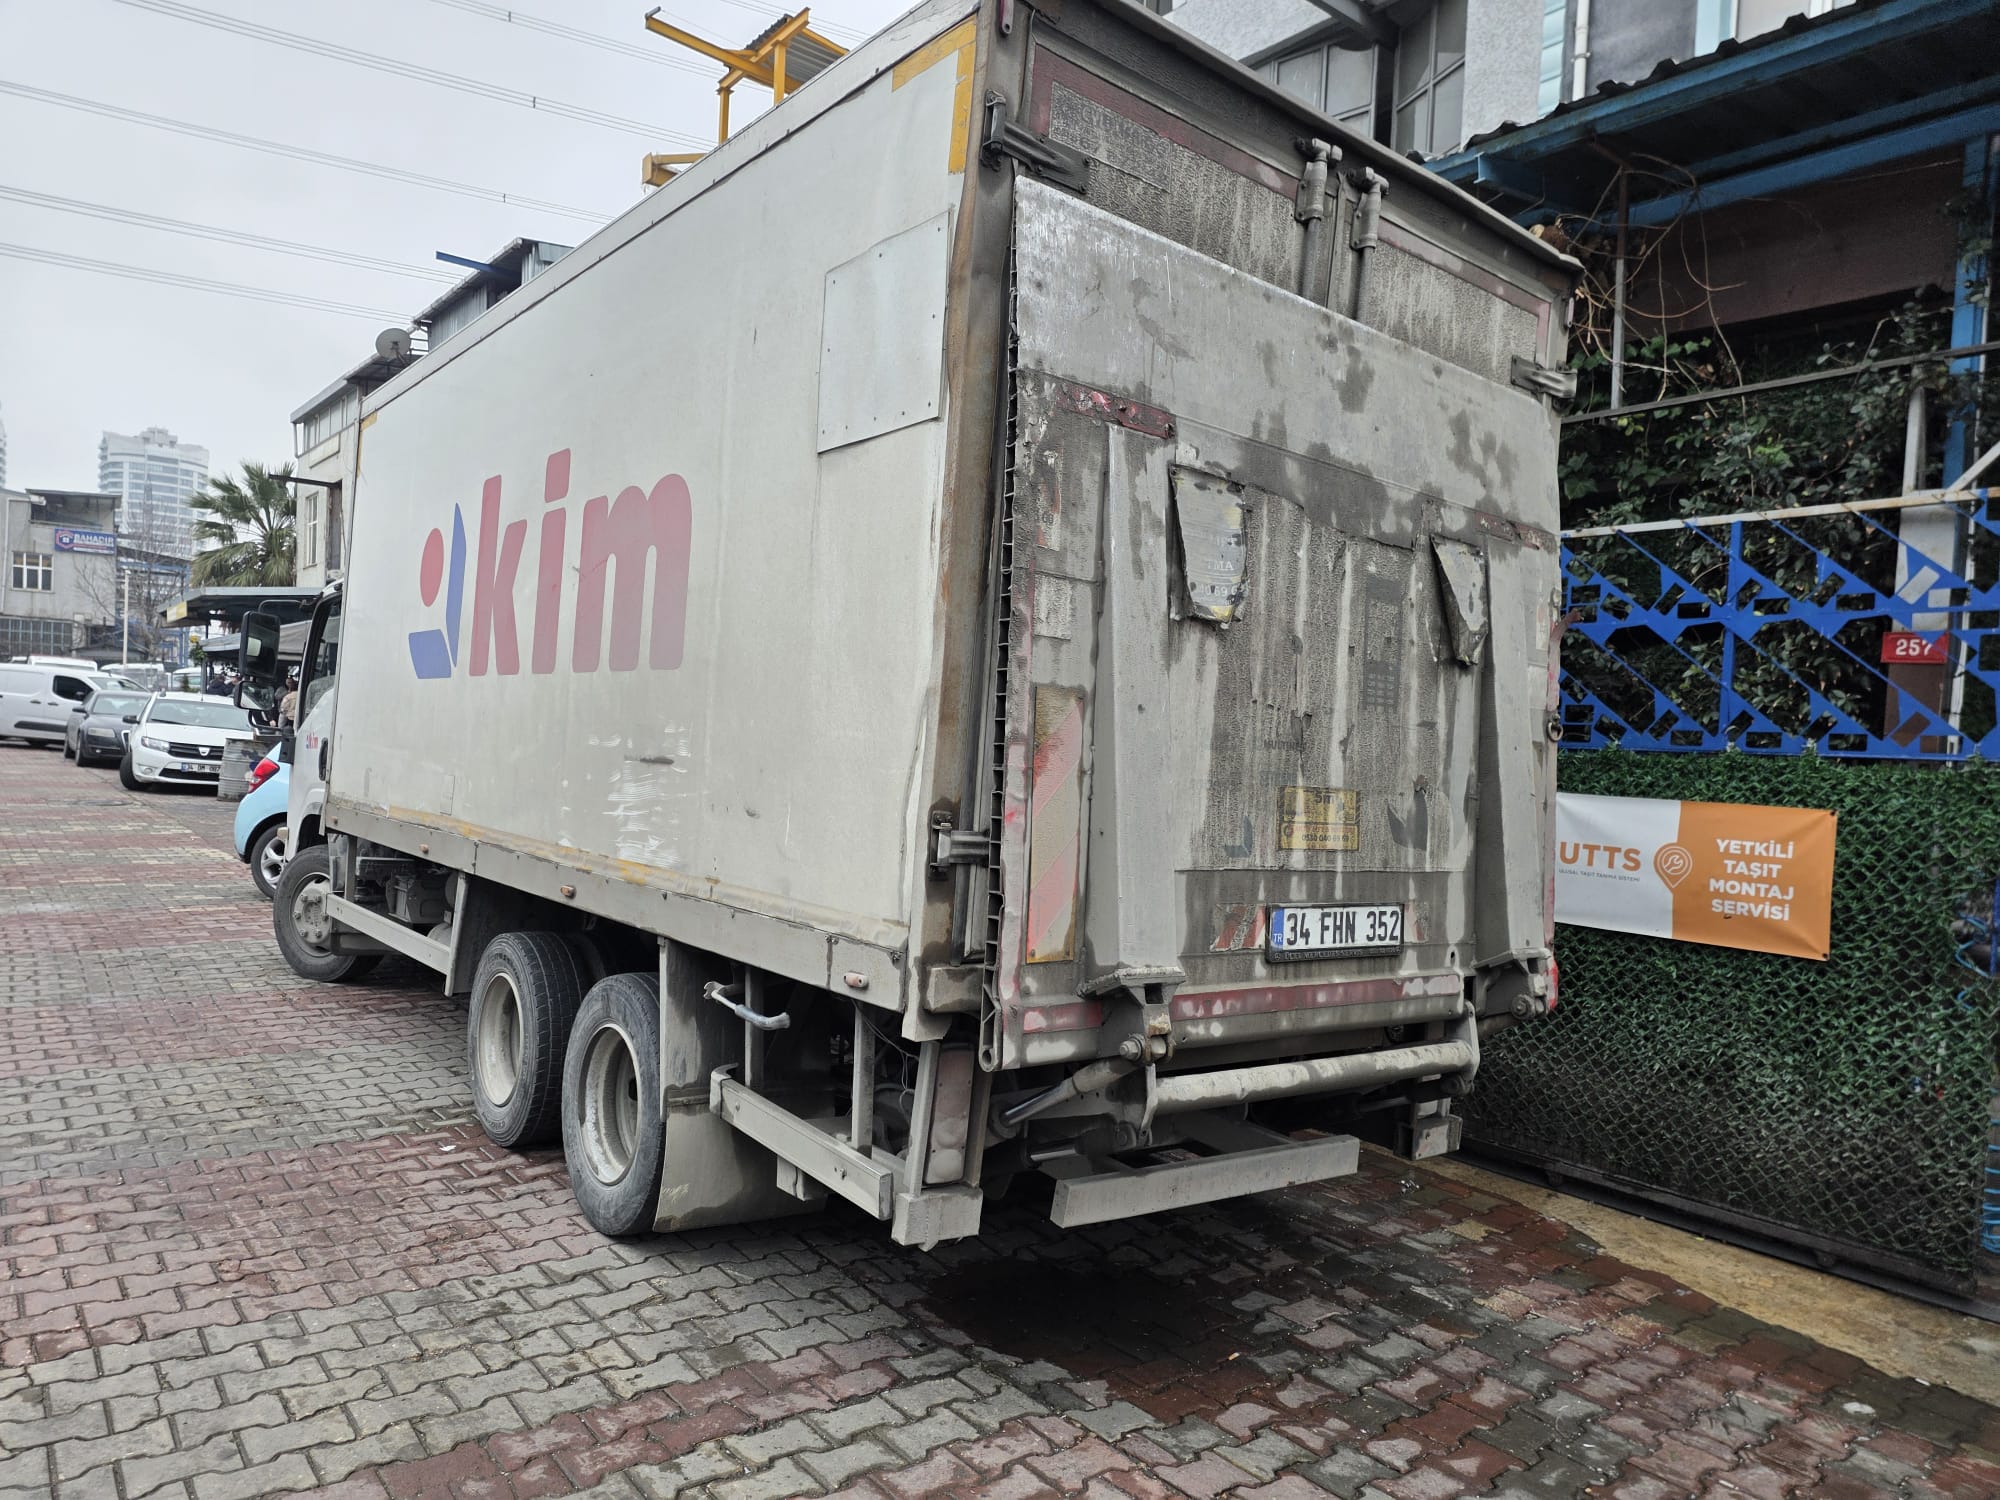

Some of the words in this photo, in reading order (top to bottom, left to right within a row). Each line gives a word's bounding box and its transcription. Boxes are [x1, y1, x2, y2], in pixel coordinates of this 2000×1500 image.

[468, 447, 693, 677] kim
[1895, 638, 1933, 656] 257
[1559, 841, 1641, 872] UTTS
[1716, 837, 1794, 860] YETKİLİ
[1723, 859, 1782, 879] TAŞIT
[1709, 878, 1794, 901] MONTAJ
[1711, 898, 1790, 921] SERVİSİ
[1273, 933, 1283, 943] TR
[1286, 912, 1311, 946] 34
[1320, 910, 1356, 945] FHN
[1366, 910, 1400, 942] 352
